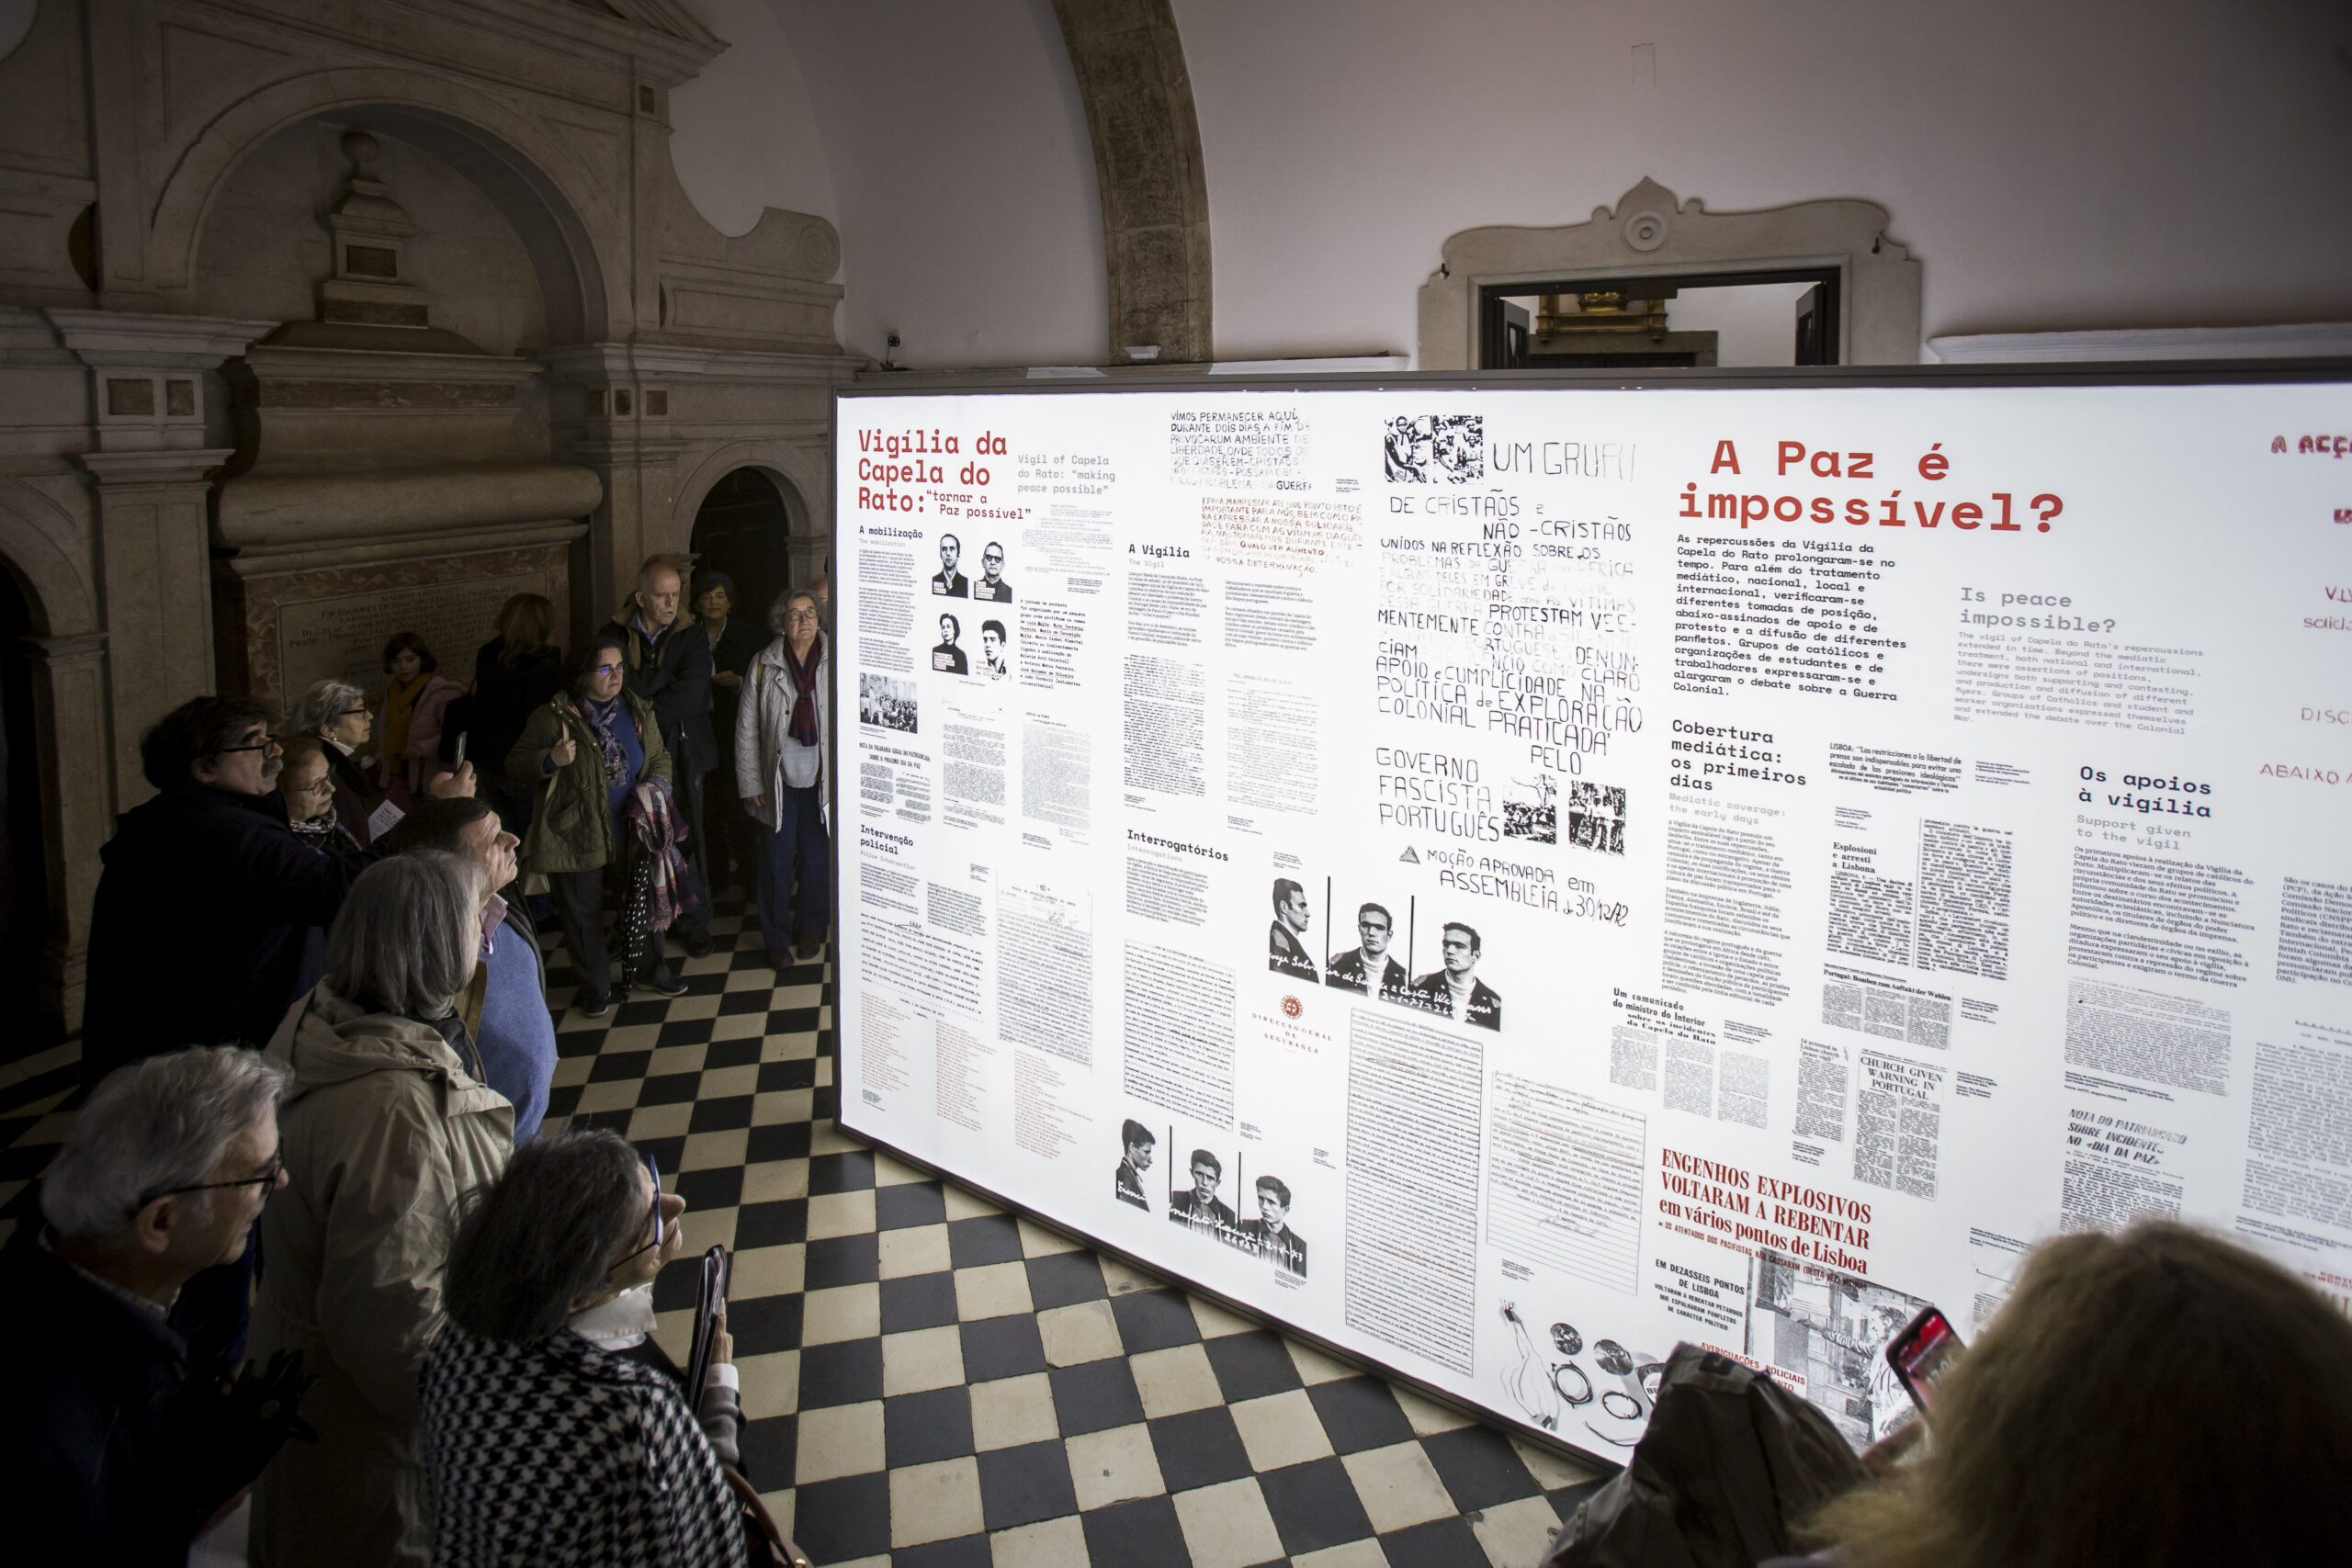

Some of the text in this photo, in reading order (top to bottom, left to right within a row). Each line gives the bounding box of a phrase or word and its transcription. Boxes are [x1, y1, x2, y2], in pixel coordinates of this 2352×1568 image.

[1171, 423, 1211, 433] DURANTE
[1200, 412, 1264, 422] PERMANECER
[858, 428, 1007, 457] Vigília da
[2271, 434, 2352, 459] A ACÇ
[1018, 454, 1109, 467] Vigil of Capela
[1493, 443, 1532, 474] UM
[1710, 440, 1949, 480] A Paz é
[858, 457, 989, 486] Capela do
[1018, 468, 1030, 478] do
[1035, 468, 1064, 479] Rato:
[859, 487, 923, 513] Rato:
[980, 495, 987, 504] a
[1018, 485, 1047, 493] peace
[940, 503, 959, 516] Paz
[1390, 489, 1520, 517] DE CRISTÃOS
[1679, 482, 2064, 536] impossível?
[859, 525, 922, 540] A mobilização
[1483, 517, 1520, 540] NÃO
[1128, 544, 1190, 558] A Vigília
[1380, 536, 1574, 559] UNIDOS NA REFLEXÃO SOBRE
[1678, 535, 1874, 553] As repercussões da Vigília da
[1677, 547, 1716, 558] Capela
[1722, 549, 1736, 558] do
[1742, 549, 1769, 559] Rato
[1775, 553, 1873, 567] prolongaram-se
[1961, 587, 2072, 607] Is peace
[1378, 609, 1479, 636] MENTEMENTE
[1489, 604, 1582, 627] PROTESTAM
[1961, 609, 2116, 634] impossible?
[1379, 639, 1418, 659] CIAM
[1376, 657, 1605, 704] APOIO CUMPLICIDADE NA
[1581, 668, 1640, 692] CLARO
[1378, 696, 1476, 728] COLONIAL
[1498, 690, 1642, 733] EXPLORAÇÃO
[1672, 719, 1773, 744] Cobertura
[1531, 746, 1582, 774] PELO
[1671, 740, 1781, 763] mediática:
[1872, 750, 1911, 759] restricciones
[1918, 752, 1925, 761] la
[1927, 753, 1952, 764] libertad
[1376, 748, 1478, 783] GOVERNO
[1671, 759, 1806, 785] os primeiros
[2260, 764, 2339, 784] ABAIXO
[1670, 773, 1713, 791] dias
[2080, 766, 2211, 795] Os apoios
[1379, 775, 1491, 812] FASCISTA
[1668, 792, 1785, 818] Mediatic coverage:
[2078, 788, 2211, 818] à vigília
[1379, 804, 1499, 842] PORTUGUÊS
[1669, 805, 1759, 826] the early days
[2076, 814, 2191, 838] Support given
[860, 839, 899, 855] policial
[861, 824, 913, 847] Intervenção
[1127, 829, 1228, 862] Interrogatórios
[2076, 828, 2180, 851] to the vigil
[1833, 841, 1877, 855] Esplosioni
[1841, 854, 1871, 863] arresti
[1427, 848, 1595, 894] MOÇÃO APROVADA em
[1842, 862, 1875, 874] Lisbona
[2085, 847, 2120, 858] primeiros
[2122, 853, 2146, 862] apoios
[2154, 857, 2193, 869] realização
[2194, 862, 2204, 870] da
[2205, 864, 2231, 875] Vigília
[2233, 867, 2243, 876] da
[1441, 871, 1558, 911] ASSEMBLEIA
[1613, 987, 1684, 1010] Um comunicado
[1852, 975, 1877, 986] Bomben
[1891, 984, 1916, 993] Auftakt
[1928, 990, 1951, 1001] Wahlen
[1612, 998, 1705, 1027] do ministro do Interior
[1860, 1056, 1943, 1082] CHURCH GIVEN
[1868, 1067, 1934, 1090] WARNING IN
[1871, 1079, 1929, 1100] PORTUGAL
[2067, 1134, 2082, 1145] NO
[2114, 1146, 2129, 1158] DA
[1662, 1148, 1871, 1224] ENGENHOS EXPLOSIVOS
[1662, 1172, 1869, 1250] VOLTARAM A REBENTAR
[1659, 1200, 1867, 1275] em vários pontos de Lisboa
[1656, 1258, 1745, 1295] EM DEZASSEIS PONTOS
[1679, 1279, 1719, 1299] DE LISBOA
